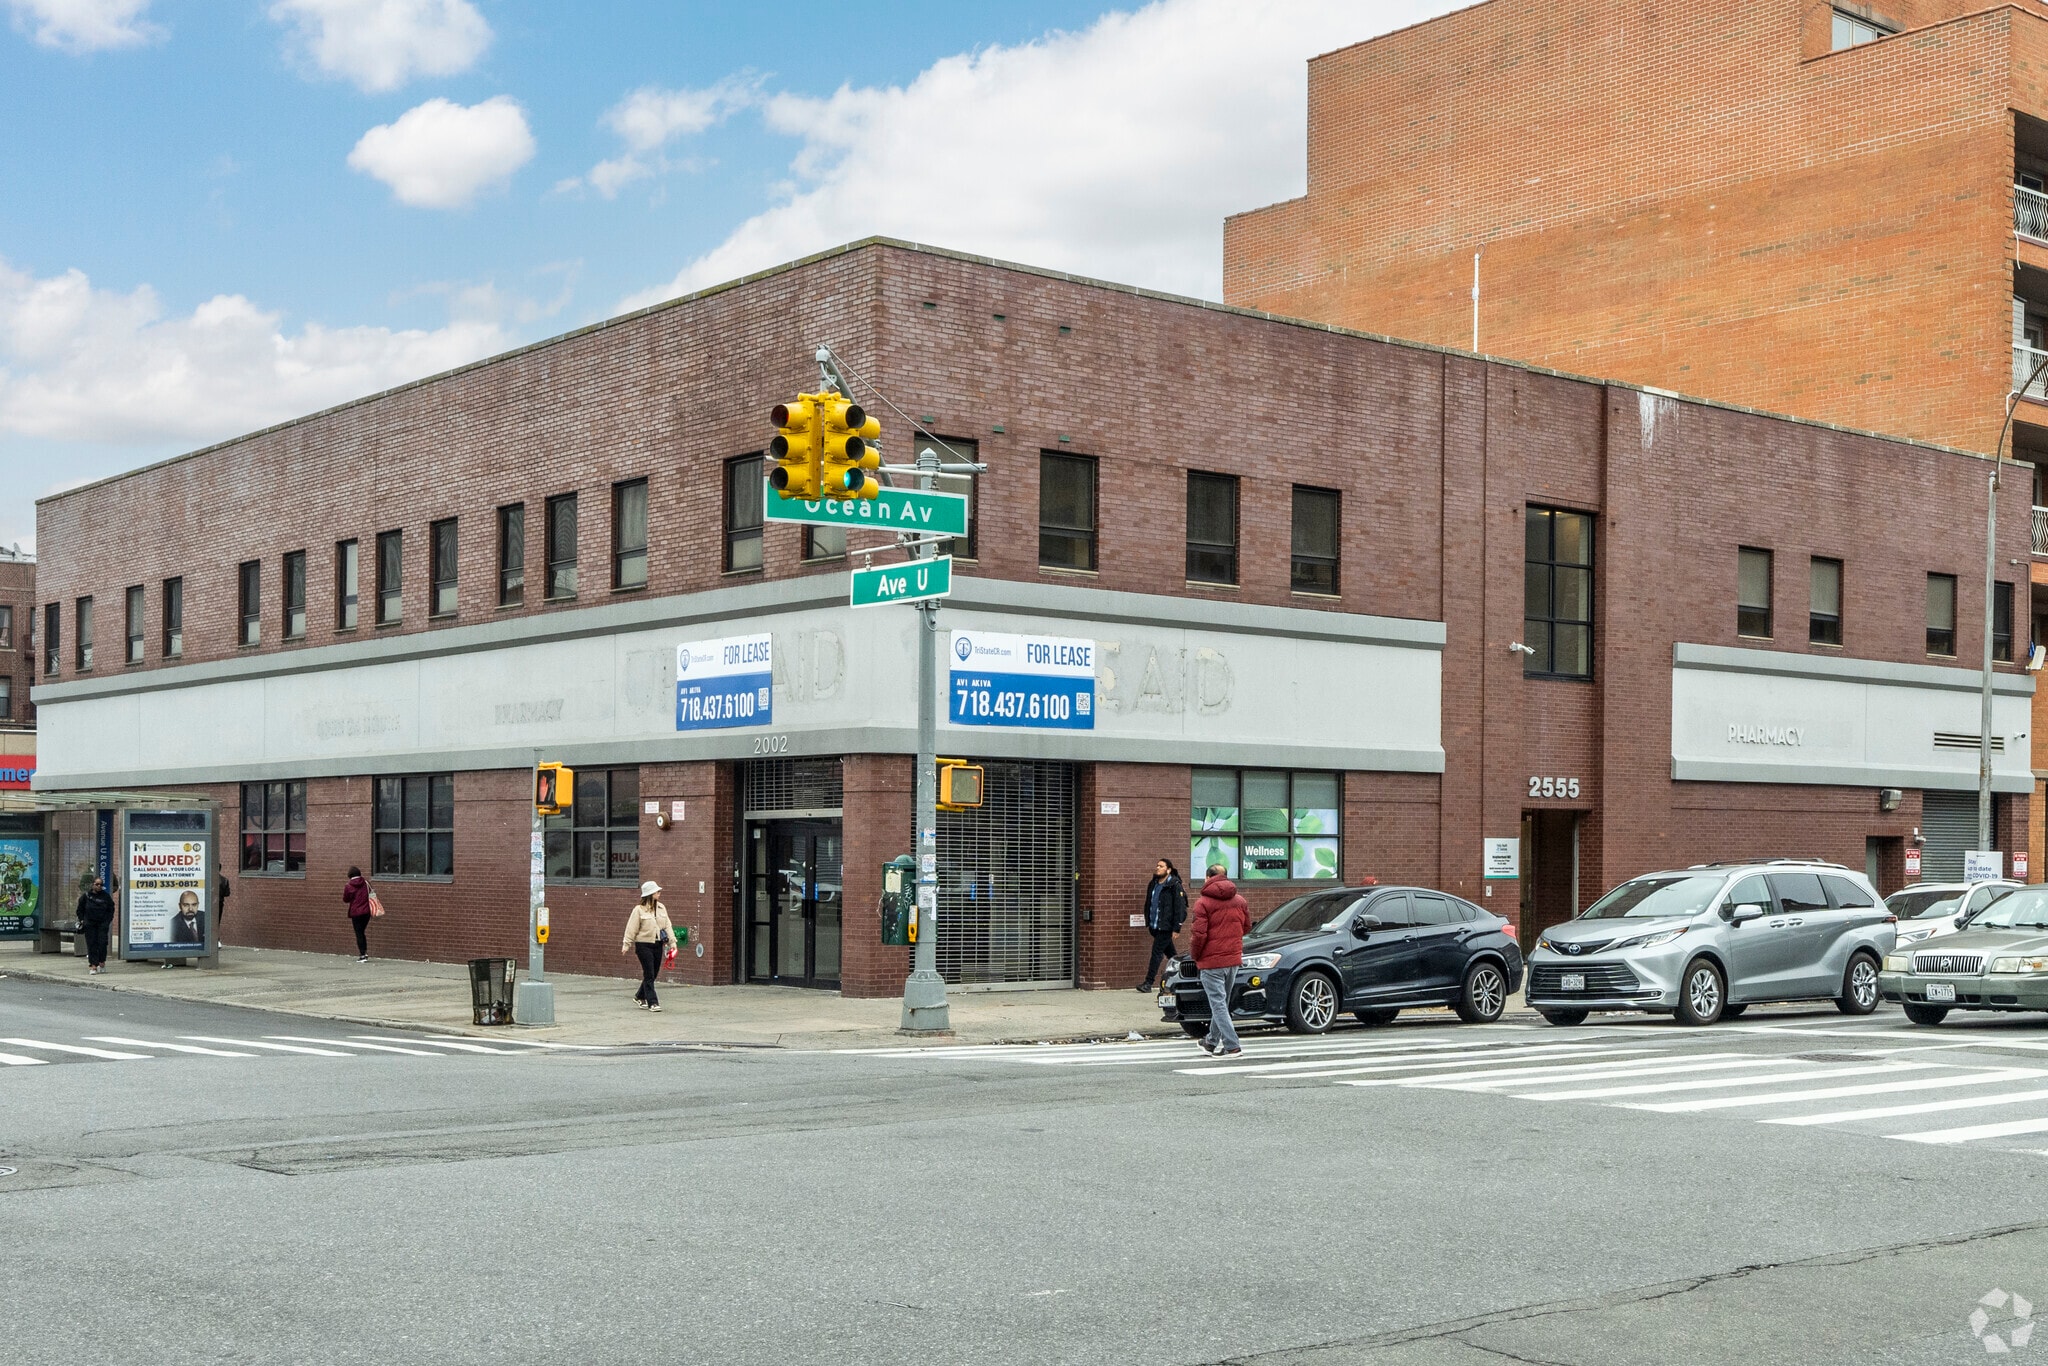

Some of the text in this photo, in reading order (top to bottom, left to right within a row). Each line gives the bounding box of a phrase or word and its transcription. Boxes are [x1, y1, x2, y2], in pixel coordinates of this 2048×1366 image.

[803, 498, 933, 523] Ocean Av
[877, 568, 929, 597] Ave U
[723, 641, 770, 665] FOR LEASE
[974, 646, 1012, 656] TriStateCR.com
[1027, 643, 1091, 667] FOR LEASE
[957, 678, 968, 687] AVI
[681, 692, 754, 722] 718.437.6100
[957, 690, 1070, 720] 718.437.6100
[754, 735, 788, 754] 2002
[1728, 723, 1805, 746] PHARMACY
[1528, 776, 1580, 798] 2555
[133, 855, 201, 865] INJURED?
[1245, 846, 1285, 856] Wellness
[1243, 860, 1253, 871] by
[136, 880, 157, 888] (718)
